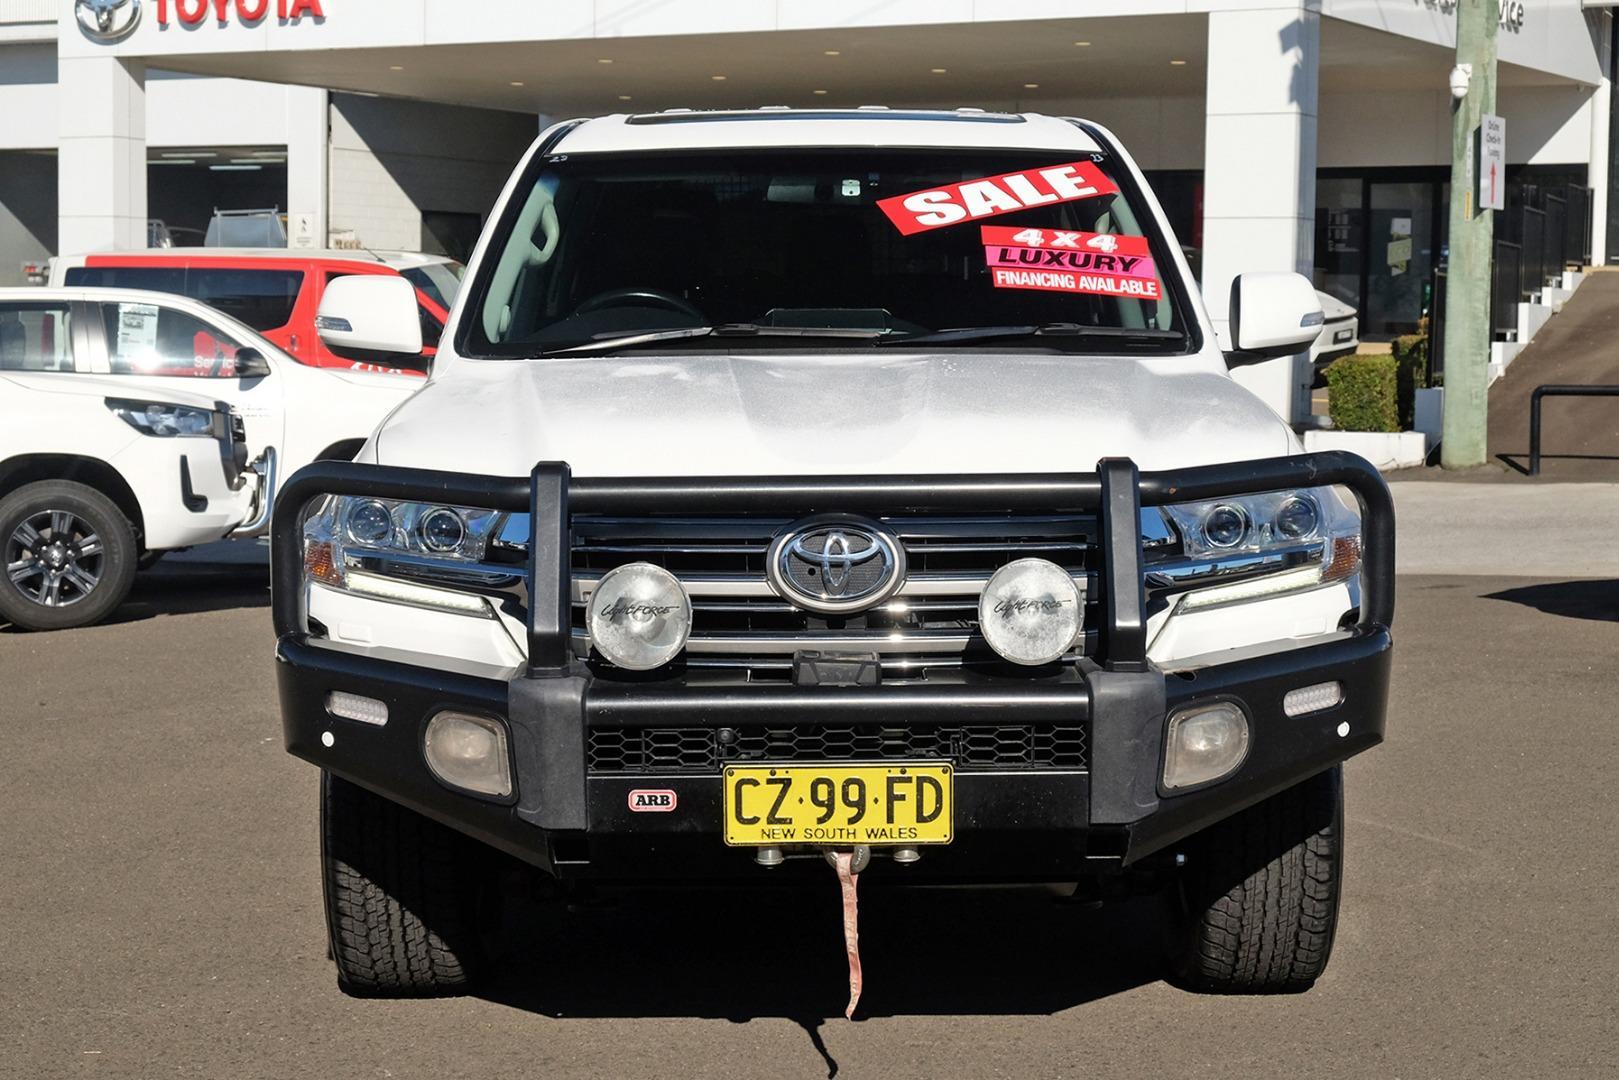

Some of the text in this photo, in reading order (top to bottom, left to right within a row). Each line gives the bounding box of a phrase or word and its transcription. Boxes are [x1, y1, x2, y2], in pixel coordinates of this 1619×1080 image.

[902, 166, 1098, 227] SALE
[998, 247, 1143, 274] LUXURY
[996, 270, 1158, 297] FINANCING AVAILABLE
[635, 794, 671, 807] ARB
[760, 826, 918, 840] NEW SOUTH WALES
